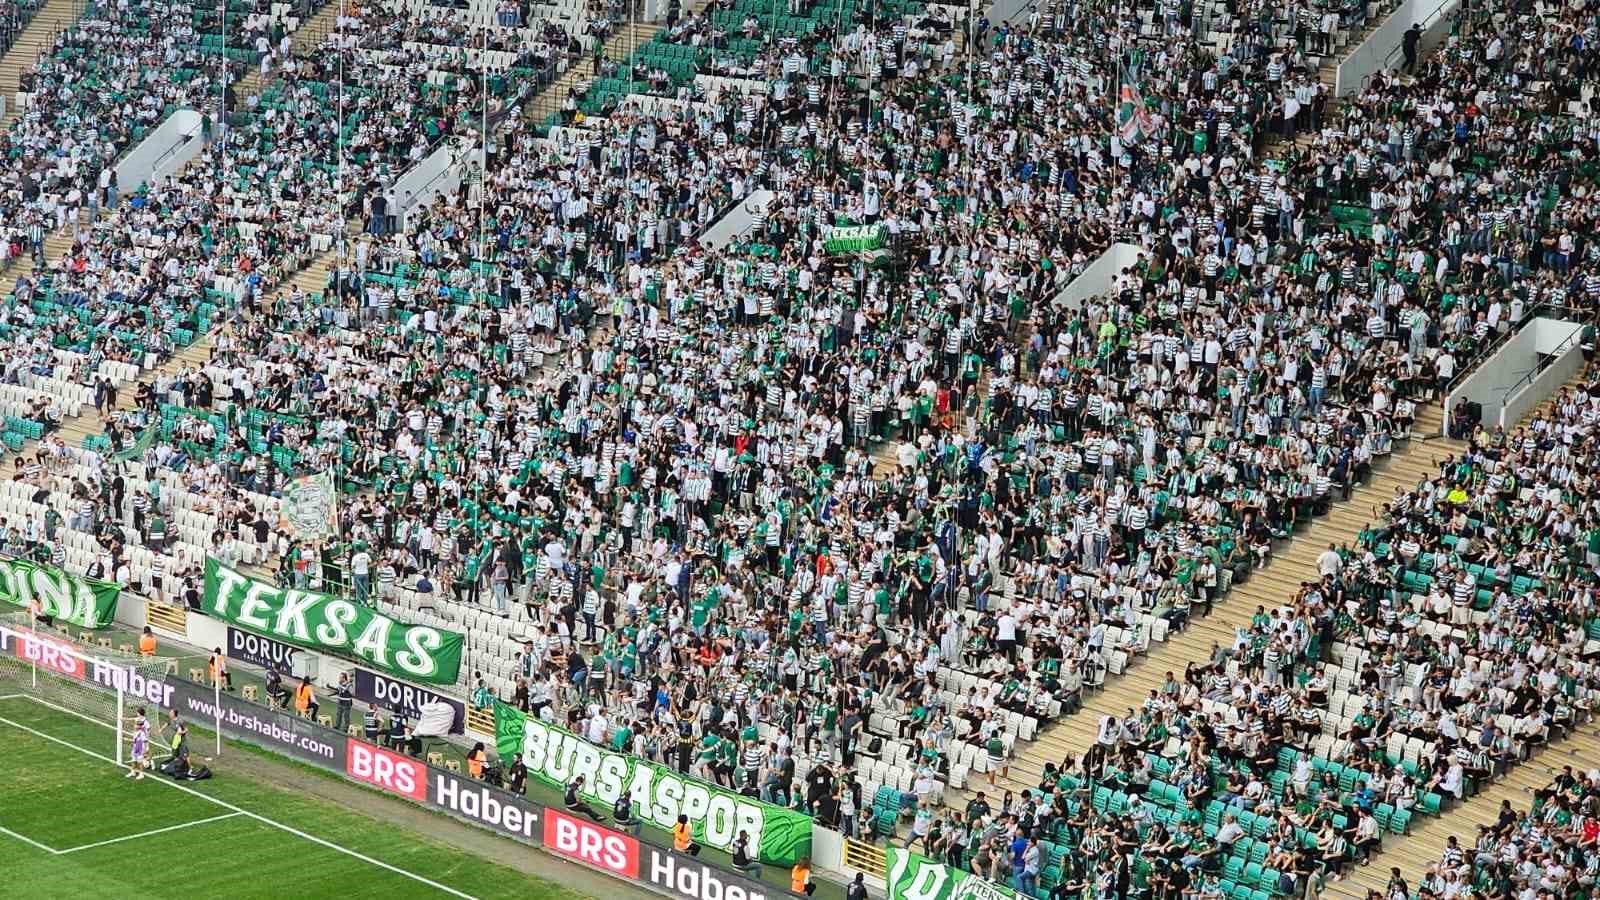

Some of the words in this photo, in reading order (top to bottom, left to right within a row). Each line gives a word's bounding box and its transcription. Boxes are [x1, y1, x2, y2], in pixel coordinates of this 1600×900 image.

[24, 631, 77, 673] BRS
[214, 565, 442, 677] TEKSAS
[187, 697, 335, 759] www.brshaber.com
[352, 745, 416, 793] BRS
[437, 775, 538, 838] Haber
[522, 718, 765, 860] BURSASPOR
[555, 817, 627, 871] BRS
